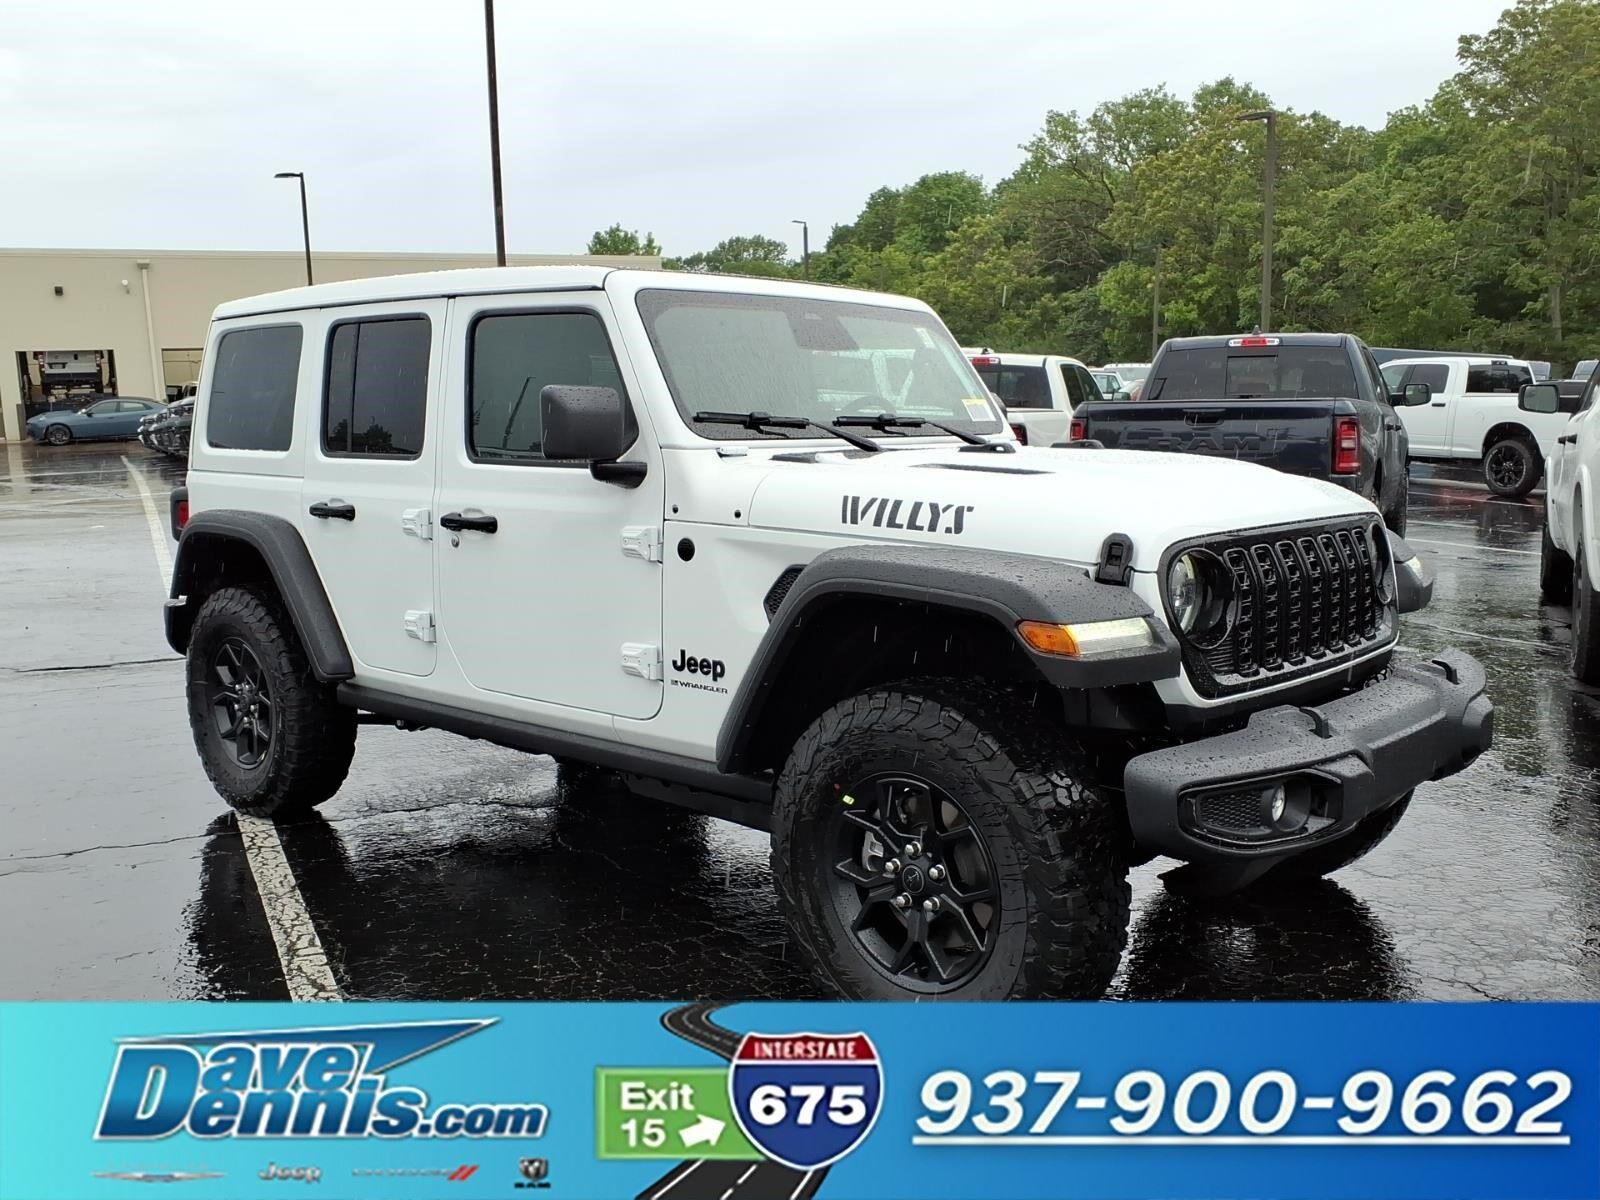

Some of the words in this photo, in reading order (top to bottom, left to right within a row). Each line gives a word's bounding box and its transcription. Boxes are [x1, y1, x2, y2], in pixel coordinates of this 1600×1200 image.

[1148, 436, 1261, 451] RAM
[841, 495, 975, 535] WILLYS
[672, 649, 726, 682] Jeep
[679, 681, 728, 694] WRANGLER
